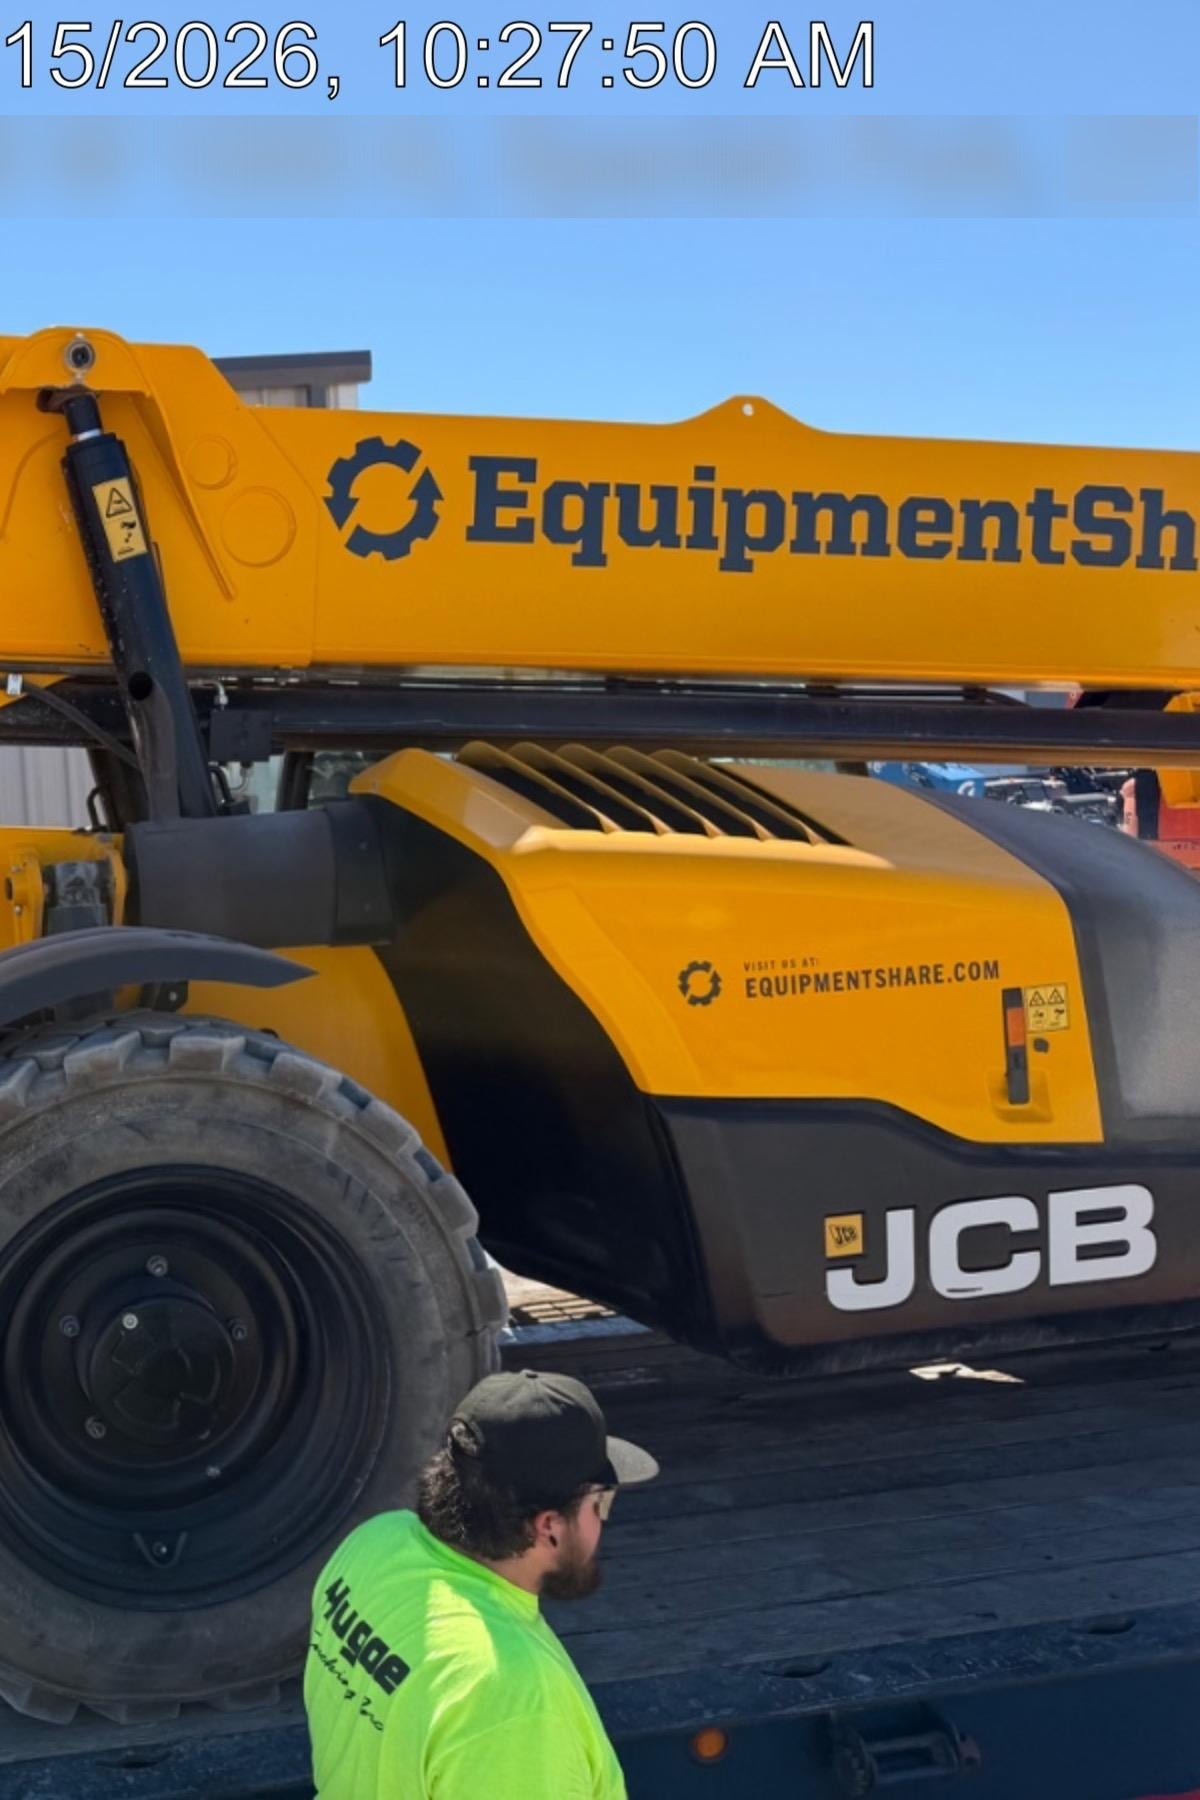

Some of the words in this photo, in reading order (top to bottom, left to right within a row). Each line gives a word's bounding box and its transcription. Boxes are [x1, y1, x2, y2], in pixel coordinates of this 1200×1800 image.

[466, 455, 1199, 573] EquipmentSh
[743, 959, 777, 973] VISIT
[780, 958, 797, 970] US
[744, 959, 1001, 999] EQUIPMENTSHARE.COM
[825, 1183, 1158, 1311] JCB
